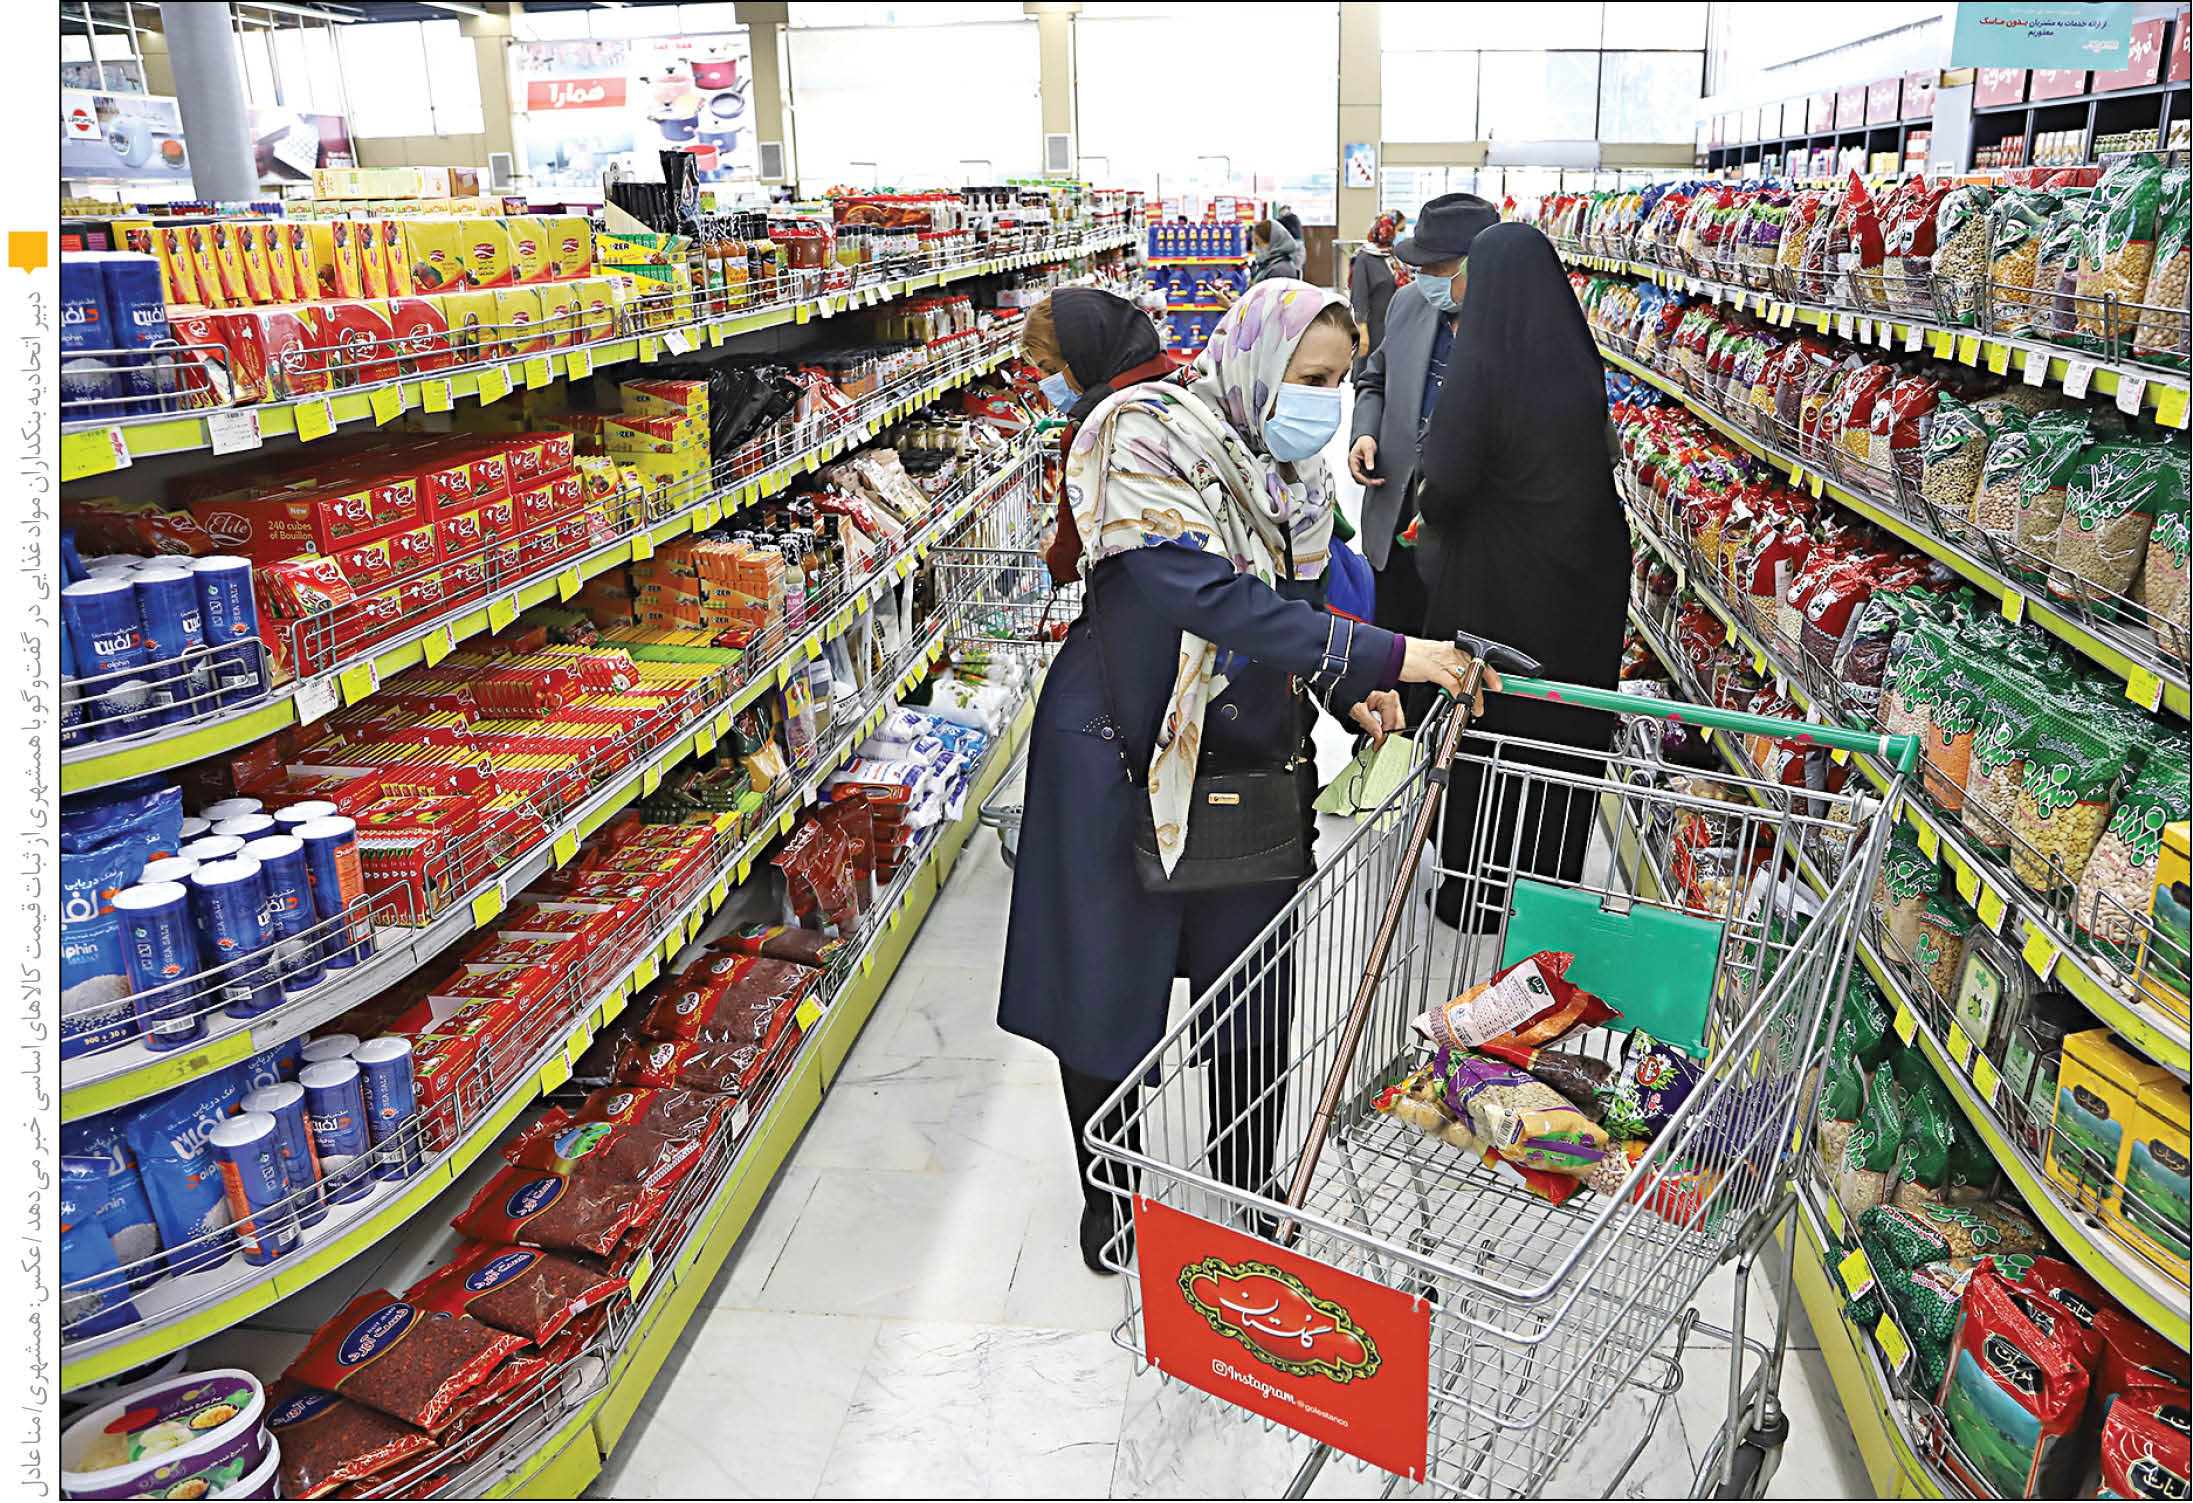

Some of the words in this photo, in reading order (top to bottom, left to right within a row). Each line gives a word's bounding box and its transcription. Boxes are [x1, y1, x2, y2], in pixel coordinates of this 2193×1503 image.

[132, 305, 168, 326] لفین
[209, 513, 250, 534] Elite
[267, 520, 285, 531] 240
[287, 521, 312, 531] cubes
[269, 531, 279, 540] of
[280, 531, 313, 540] Bouillon
[94, 633, 141, 655] دلفین
[64, 877, 99, 890] دریایی
[1218, 1291, 1334, 1348] گلستان
[1228, 1365, 1297, 1405] Instagram
[1296, 1399, 1350, 1428] @golestanco
